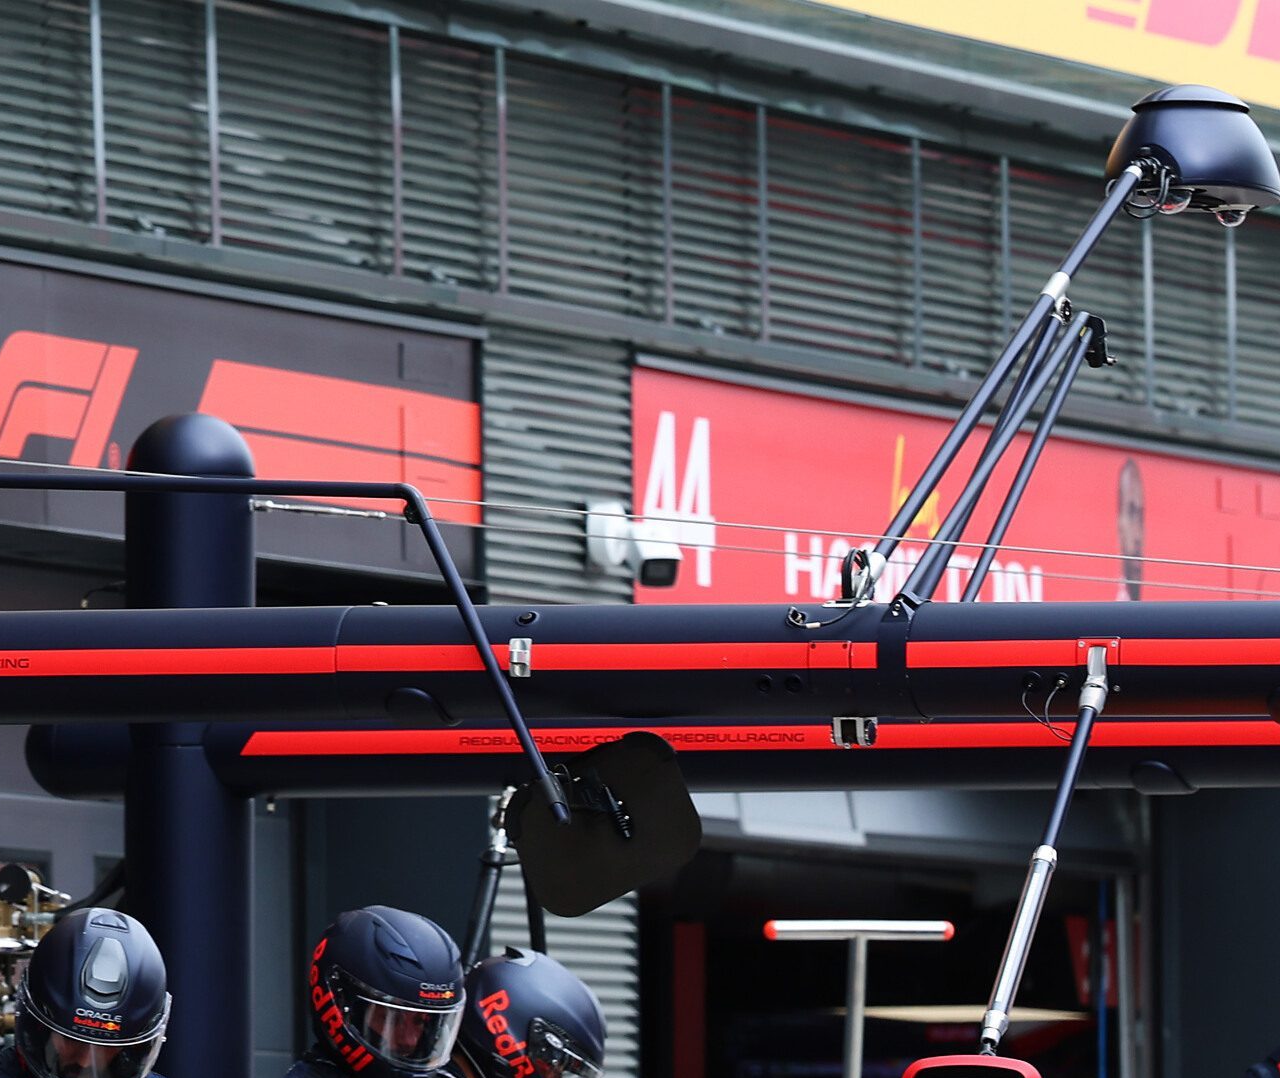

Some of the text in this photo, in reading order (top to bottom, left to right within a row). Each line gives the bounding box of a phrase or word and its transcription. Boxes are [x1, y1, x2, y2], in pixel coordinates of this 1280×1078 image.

[642, 410, 716, 588] 44
[419, 981, 455, 991] ORACLE
[75, 1007, 123, 1023] ORACLE
[478, 989, 528, 1058] Red
